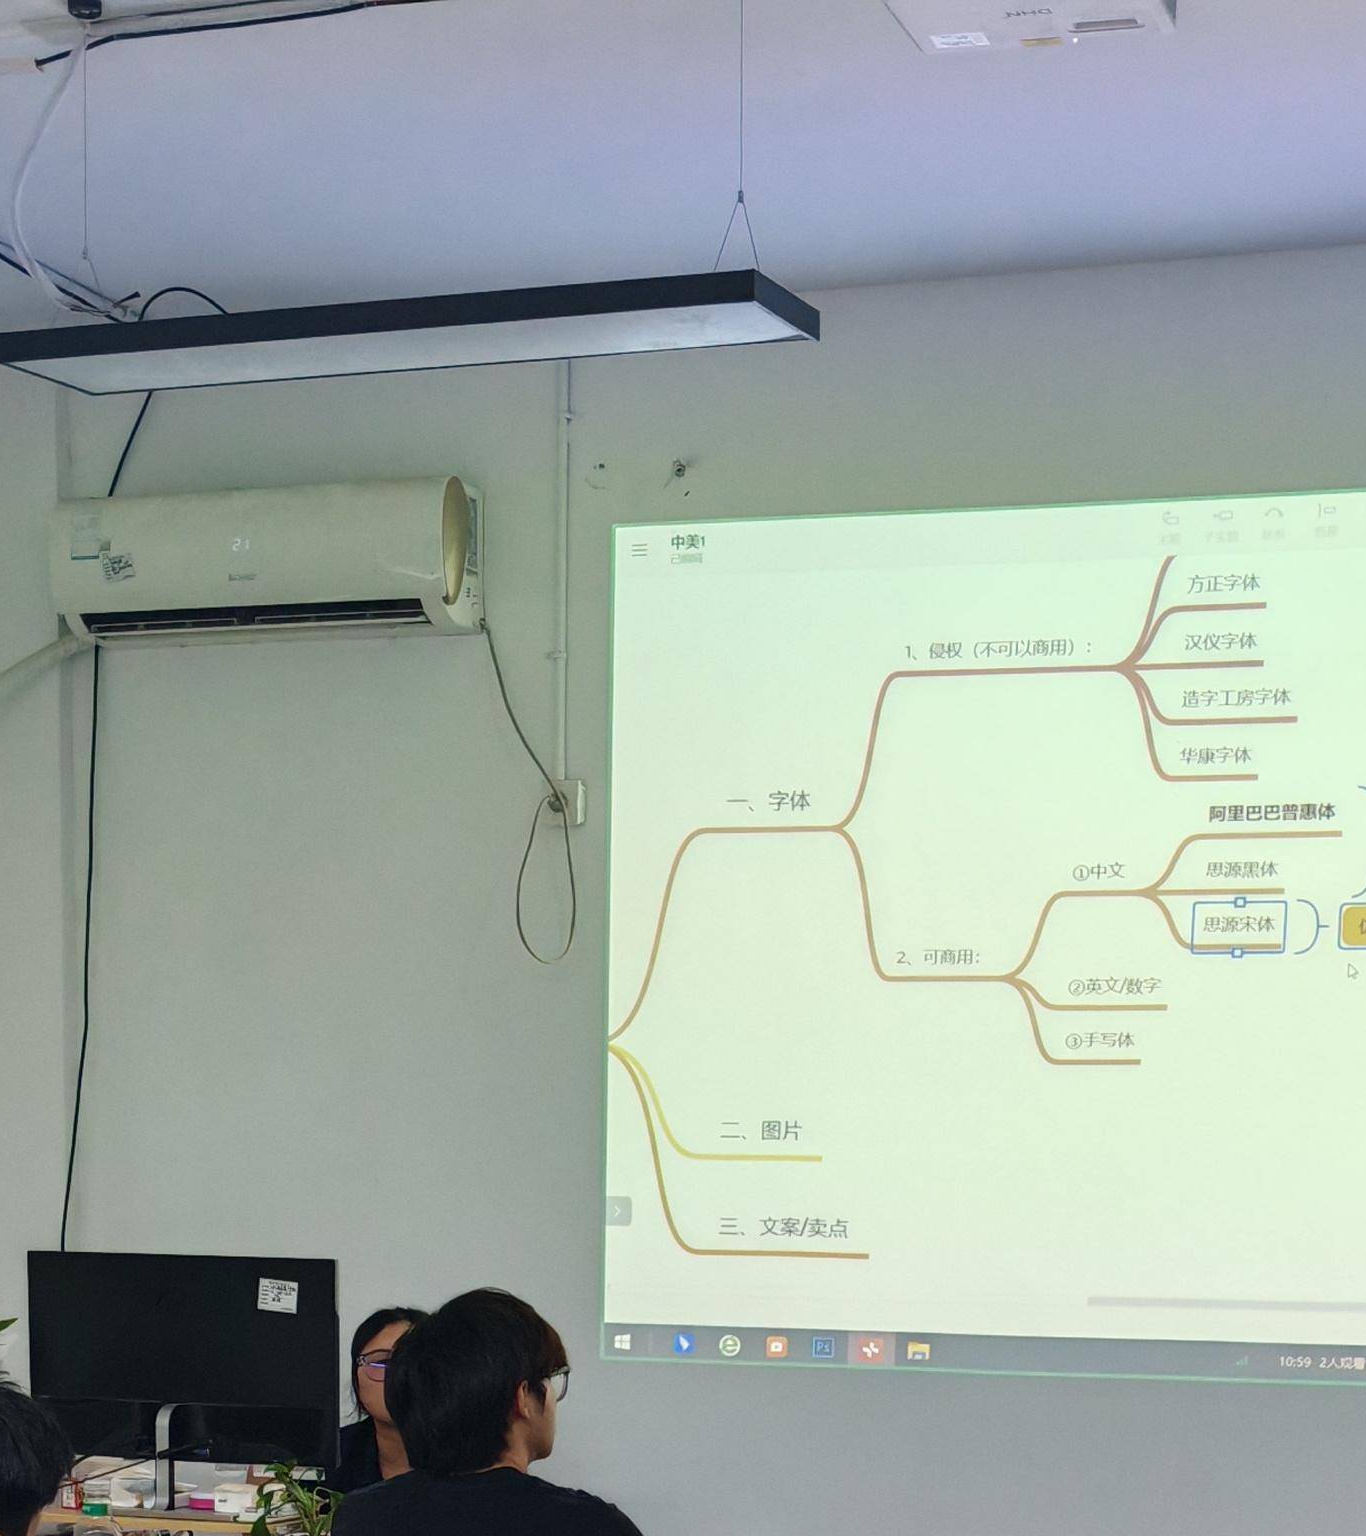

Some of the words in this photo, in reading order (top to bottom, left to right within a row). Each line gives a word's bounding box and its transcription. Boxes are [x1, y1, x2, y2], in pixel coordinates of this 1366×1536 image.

[1187, 574, 1261, 594] 方正字体
[1185, 633, 1258, 652] 汉仪字体
[1182, 688, 1292, 709] 造字工房字体
[1179, 746, 1252, 765] 华康字体
[727, 789, 811, 812] 一、字体
[1208, 802, 1336, 823] 阿里巴巴普惠体
[1206, 860, 1279, 879] 思源黑体
[1203, 915, 1276, 934] 思源宋体
[720, 1119, 803, 1142] 二、图片
[718, 1216, 850, 1239] 三、文案/卖点
[1279, 1355, 1313, 1369] 10:59
